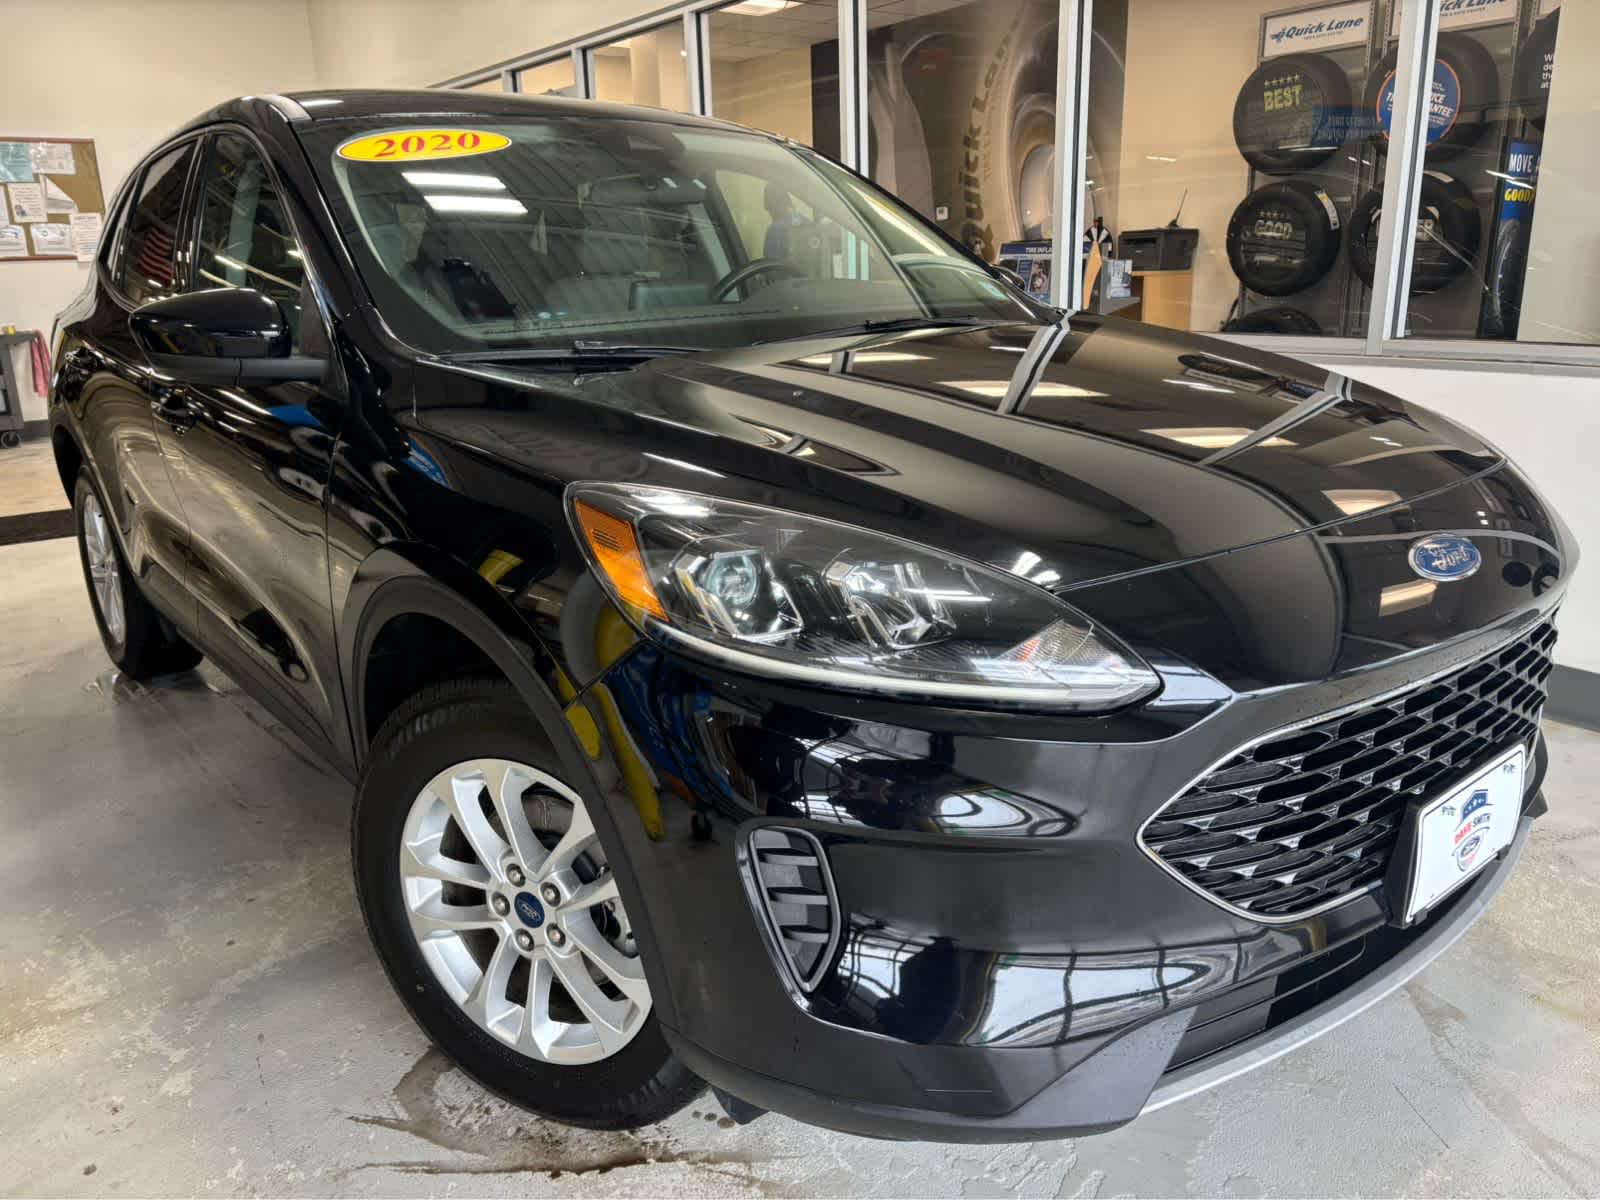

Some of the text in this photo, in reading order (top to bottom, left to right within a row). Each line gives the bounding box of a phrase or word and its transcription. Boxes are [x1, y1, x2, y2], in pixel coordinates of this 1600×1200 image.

[1284, 21, 1326, 39] Quick
[1327, 17, 1363, 31] Lane
[1264, 85, 1303, 112] BEST
[373, 132, 482, 158] 2020
[1509, 153, 1534, 172] MOVE
[958, 118, 996, 260] Quick
[1254, 219, 1293, 240] GOOD
